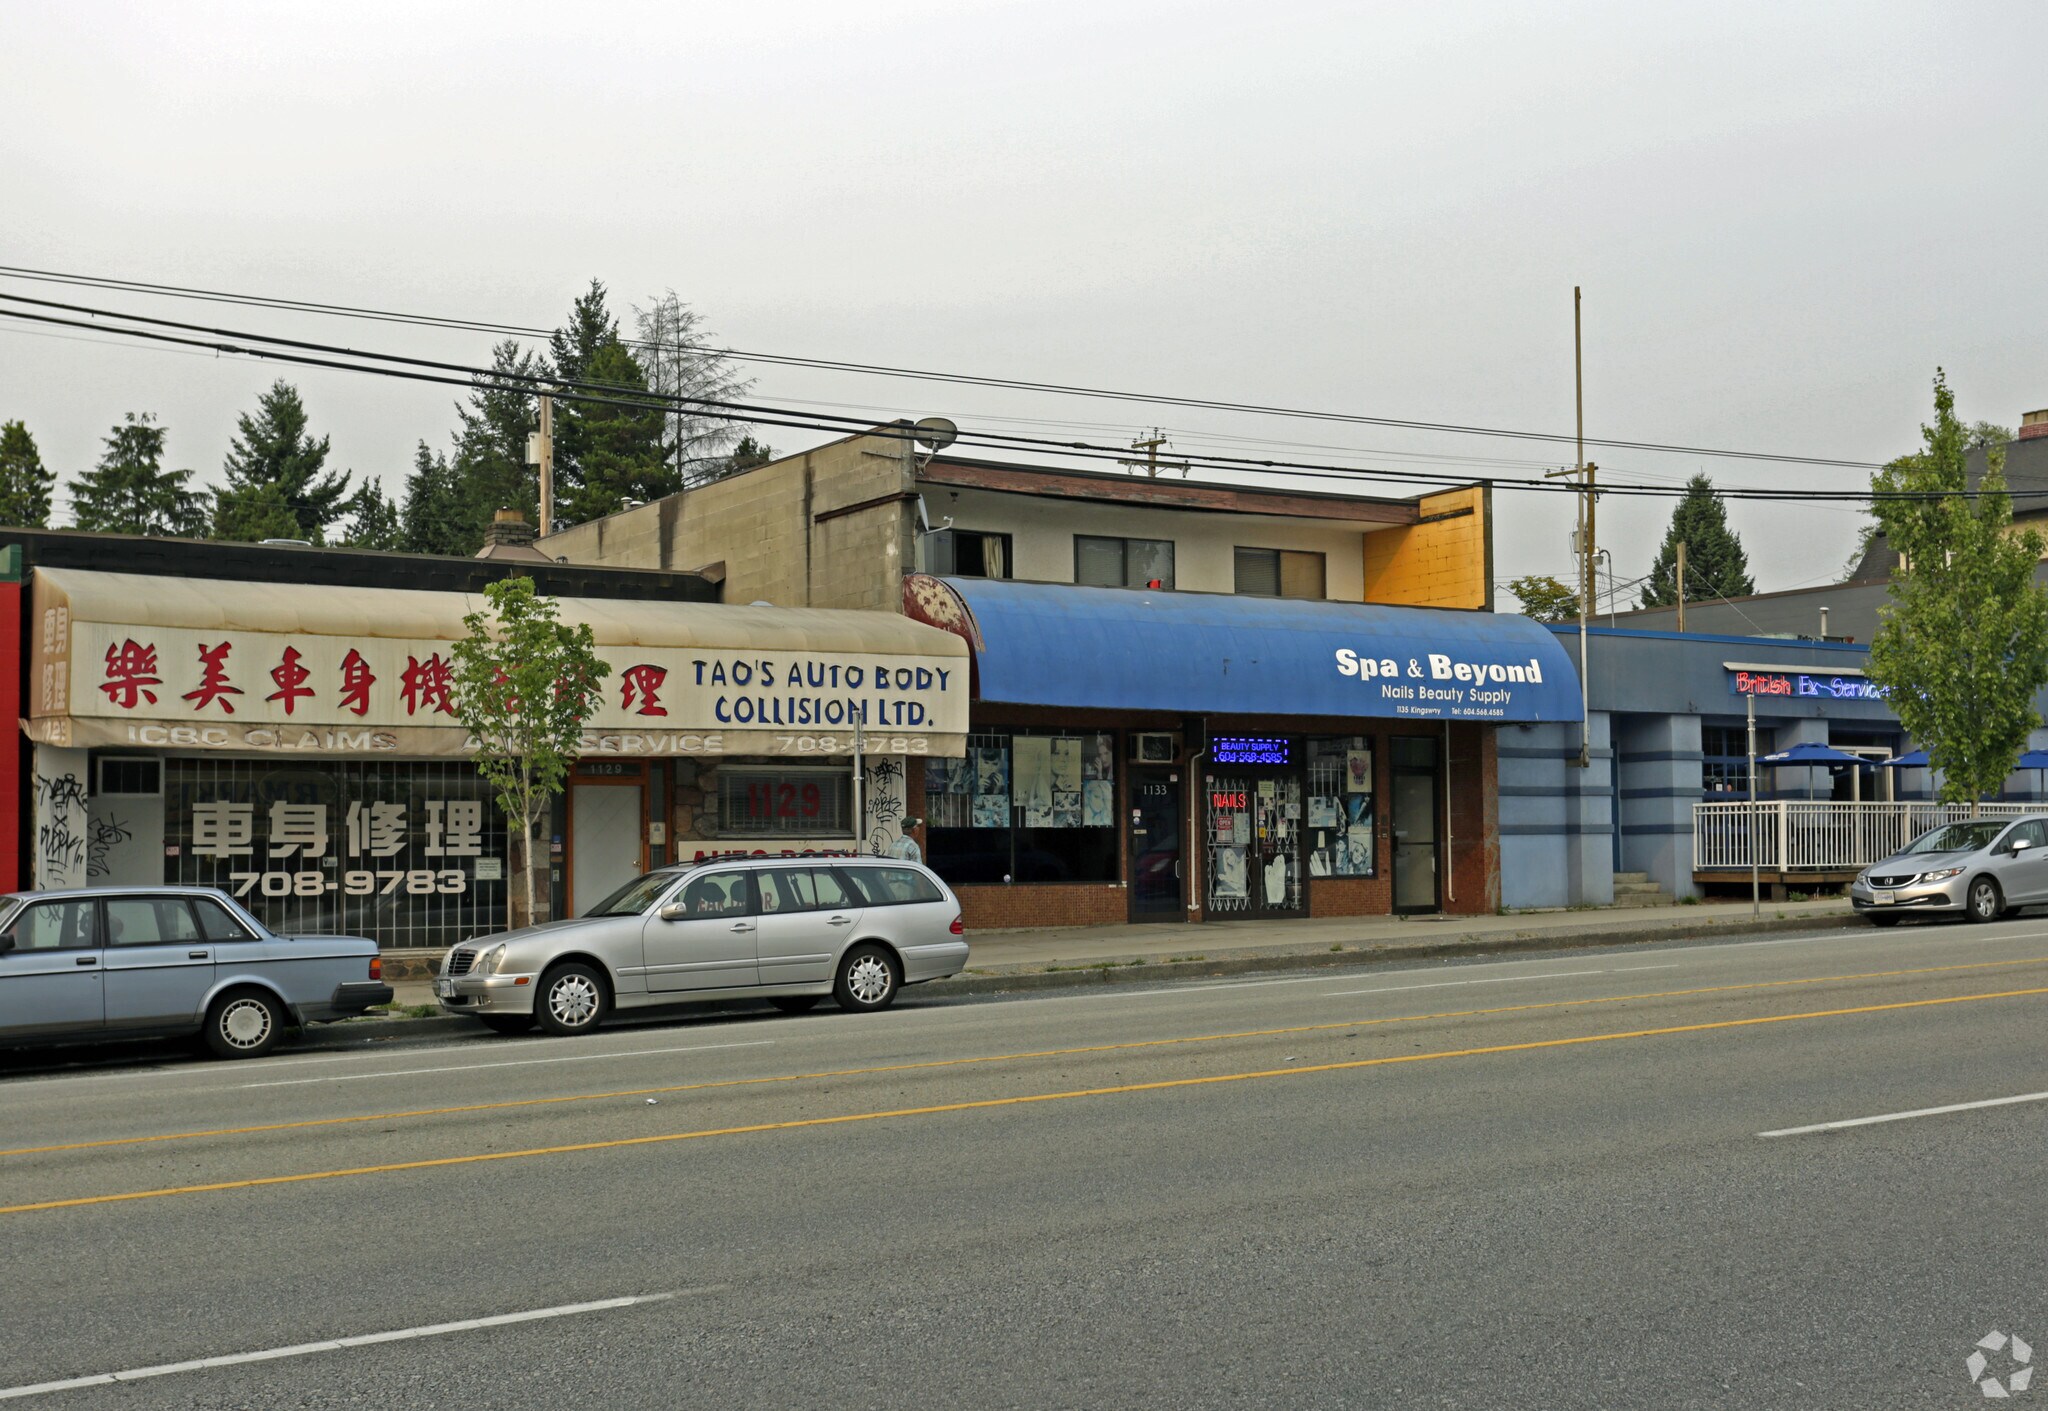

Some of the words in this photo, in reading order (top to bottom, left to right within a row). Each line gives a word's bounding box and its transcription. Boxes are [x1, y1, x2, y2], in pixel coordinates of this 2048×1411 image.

[99, 637, 668, 719] 樂美車身機理
[692, 659, 775, 688] TAO'S
[787, 662, 865, 690] AUTO
[875, 665, 951, 692] BODY
[1335, 648, 1399, 681] Spa
[1407, 658, 1424, 679] &
[1428, 654, 1543, 686] Beyond
[1382, 685, 1414, 699] Nails
[1419, 686, 1464, 703] Beauty
[1469, 688, 1511, 704] Supply
[715, 695, 867, 726] COLLISION
[879, 699, 934, 727] LTD.
[128, 725, 228, 747] ICBC
[244, 728, 399, 750] CLAIMS
[1221, 742, 1250, 751] BEAUTY
[1251, 743, 1279, 752] SUPPLY
[590, 764, 622, 775] 1129
[1218, 751, 1283, 762] 604-568-4585
[748, 783, 820, 817] 1129
[1143, 784, 1168, 796] 1133
[1213, 793, 1247, 808] NAILS
[191, 800, 482, 858] 車身修理
[229, 869, 467, 898] 708-9783
